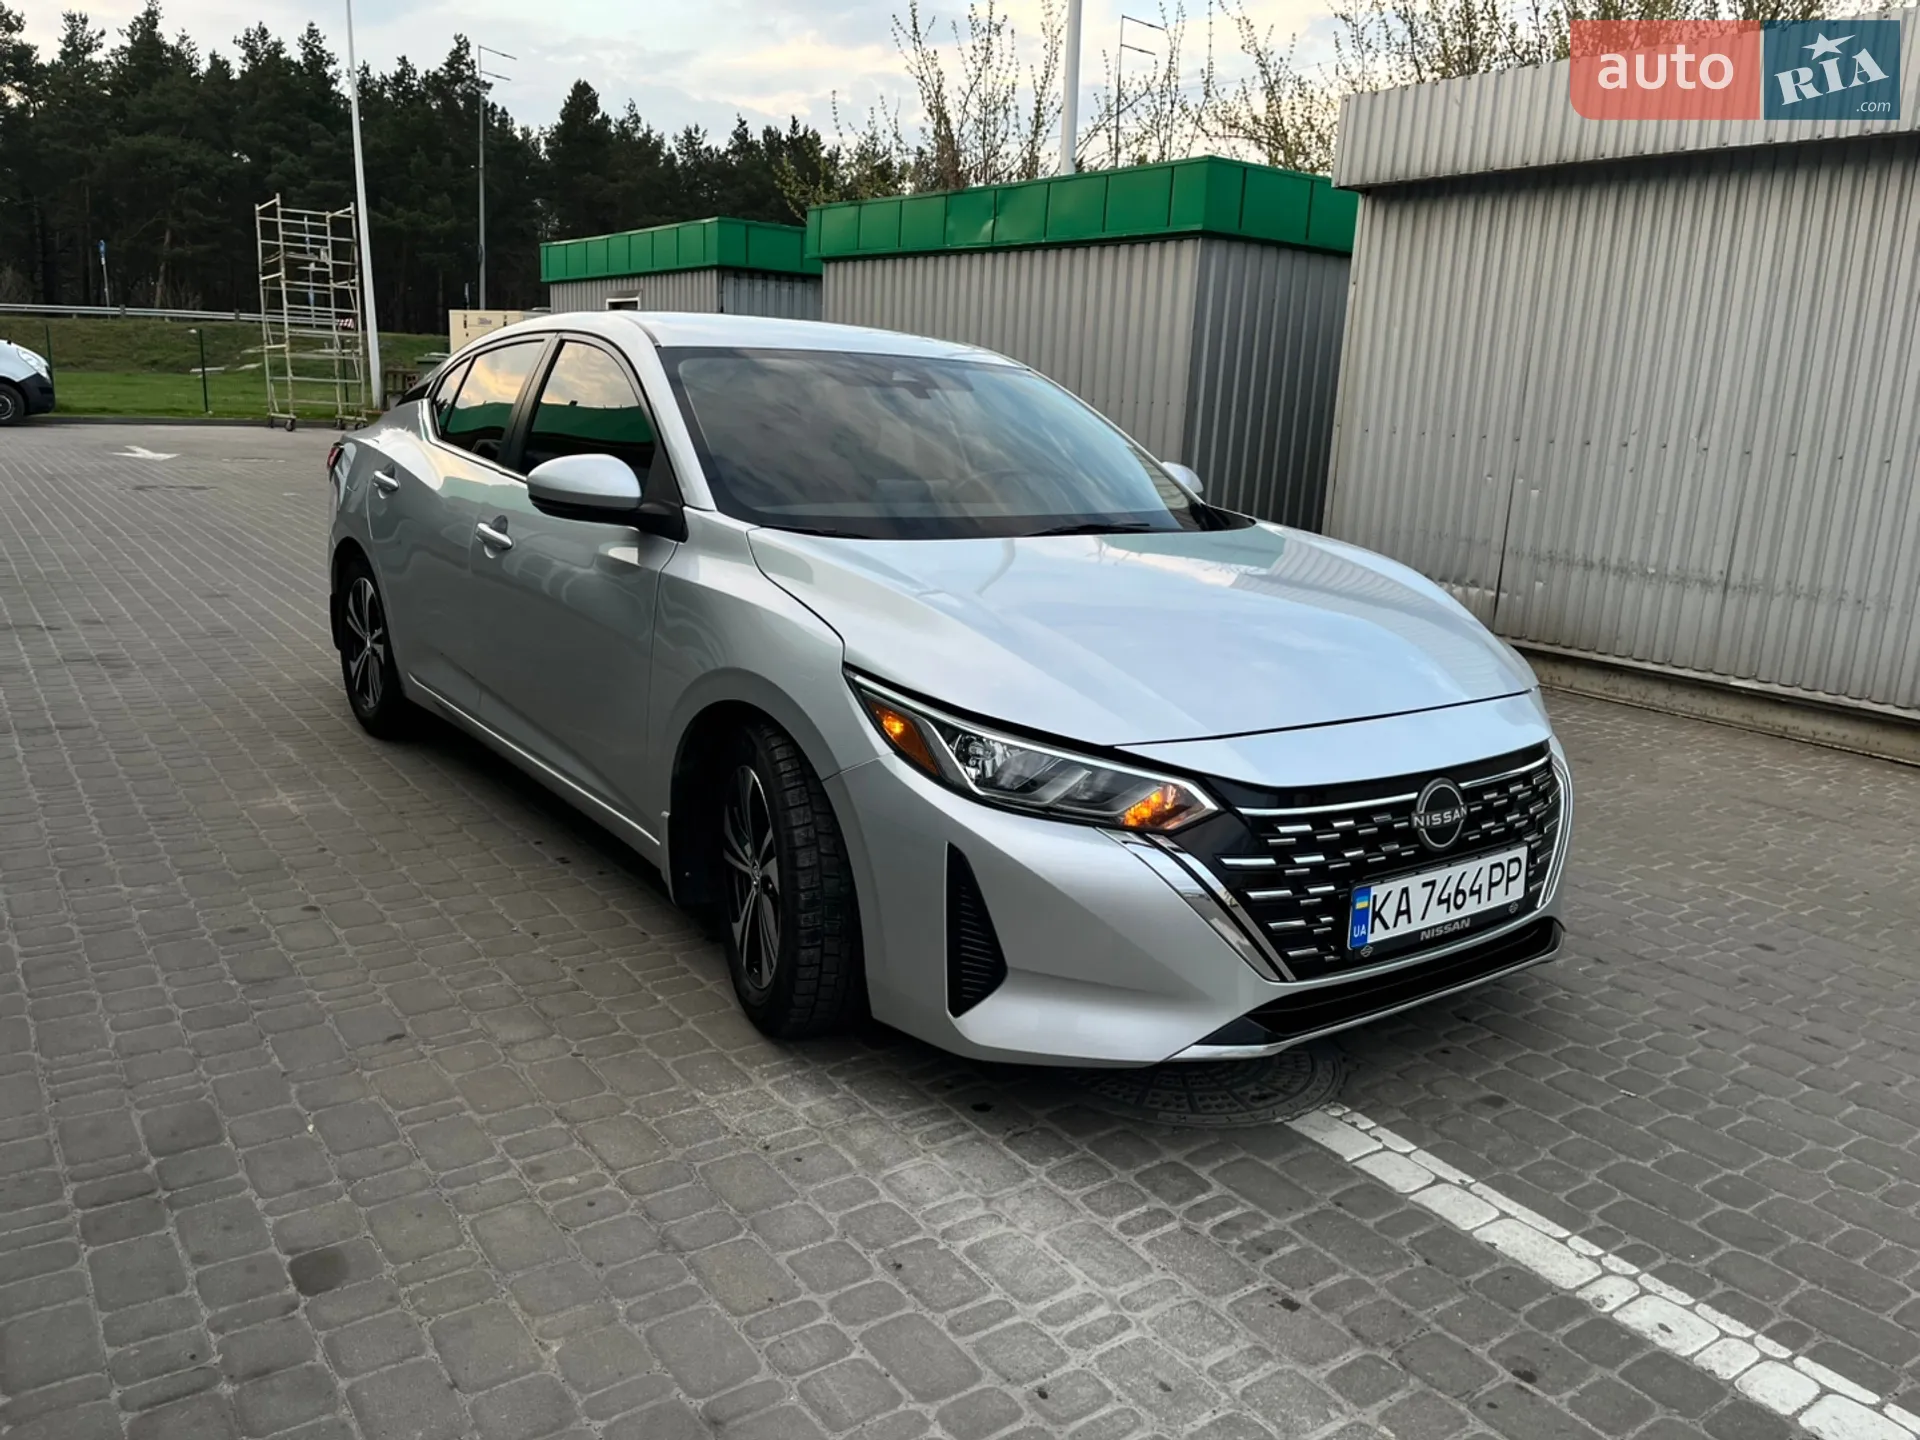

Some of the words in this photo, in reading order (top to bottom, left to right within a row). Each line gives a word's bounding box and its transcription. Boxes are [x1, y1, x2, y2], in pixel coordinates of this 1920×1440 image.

[1413, 805, 1468, 827] NISSAN
[1353, 924, 1367, 939] UA
[1420, 917, 1471, 942] NISSAN
